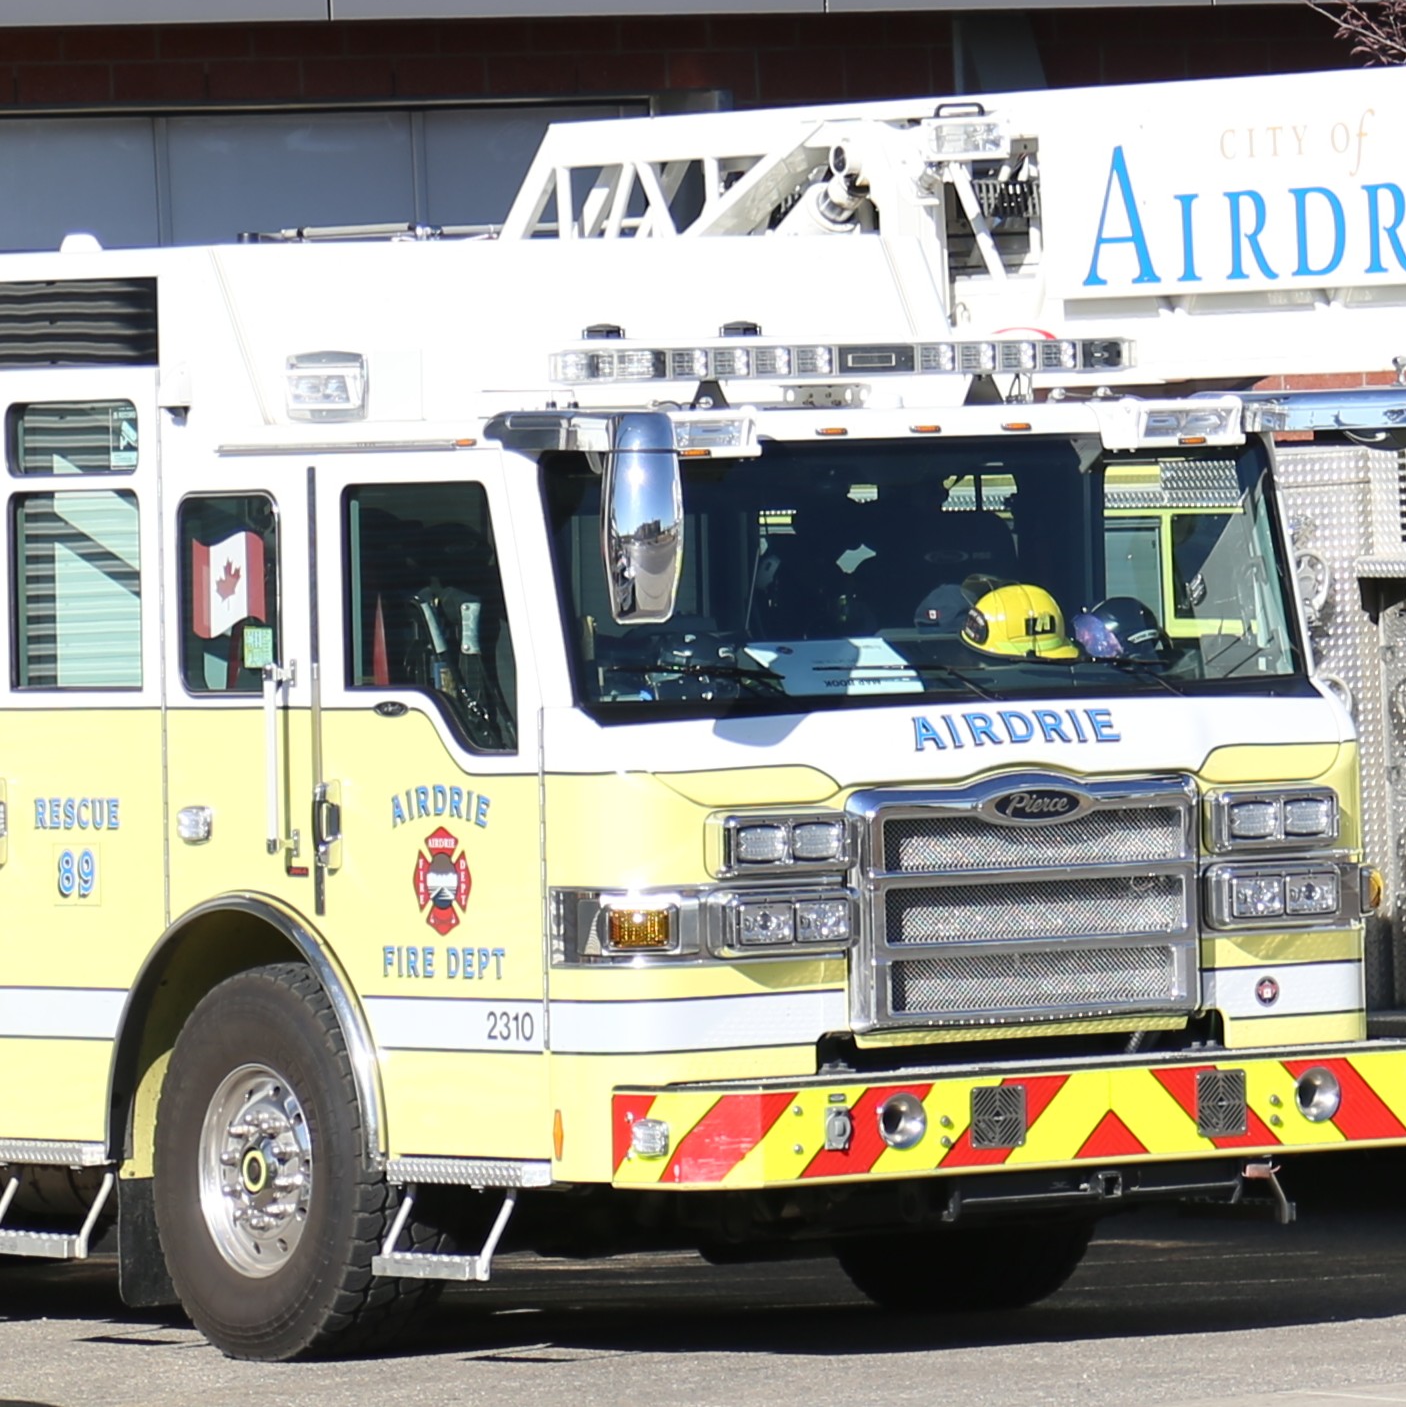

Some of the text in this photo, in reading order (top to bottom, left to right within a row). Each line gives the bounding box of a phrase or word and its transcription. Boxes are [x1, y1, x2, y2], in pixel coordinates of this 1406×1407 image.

[1219, 124, 1308, 160] CITY
[912, 708, 1122, 752] AIRDRIE
[34, 797, 120, 831] RESCUE
[391, 784, 491, 829] AIRDRIE
[1006, 793, 1070, 818] Pierce
[428, 838, 456, 849] AIRDRIE
[57, 848, 95, 899] 89
[383, 945, 506, 980] FIRE DEPT
[486, 1010, 535, 1042] 2310
